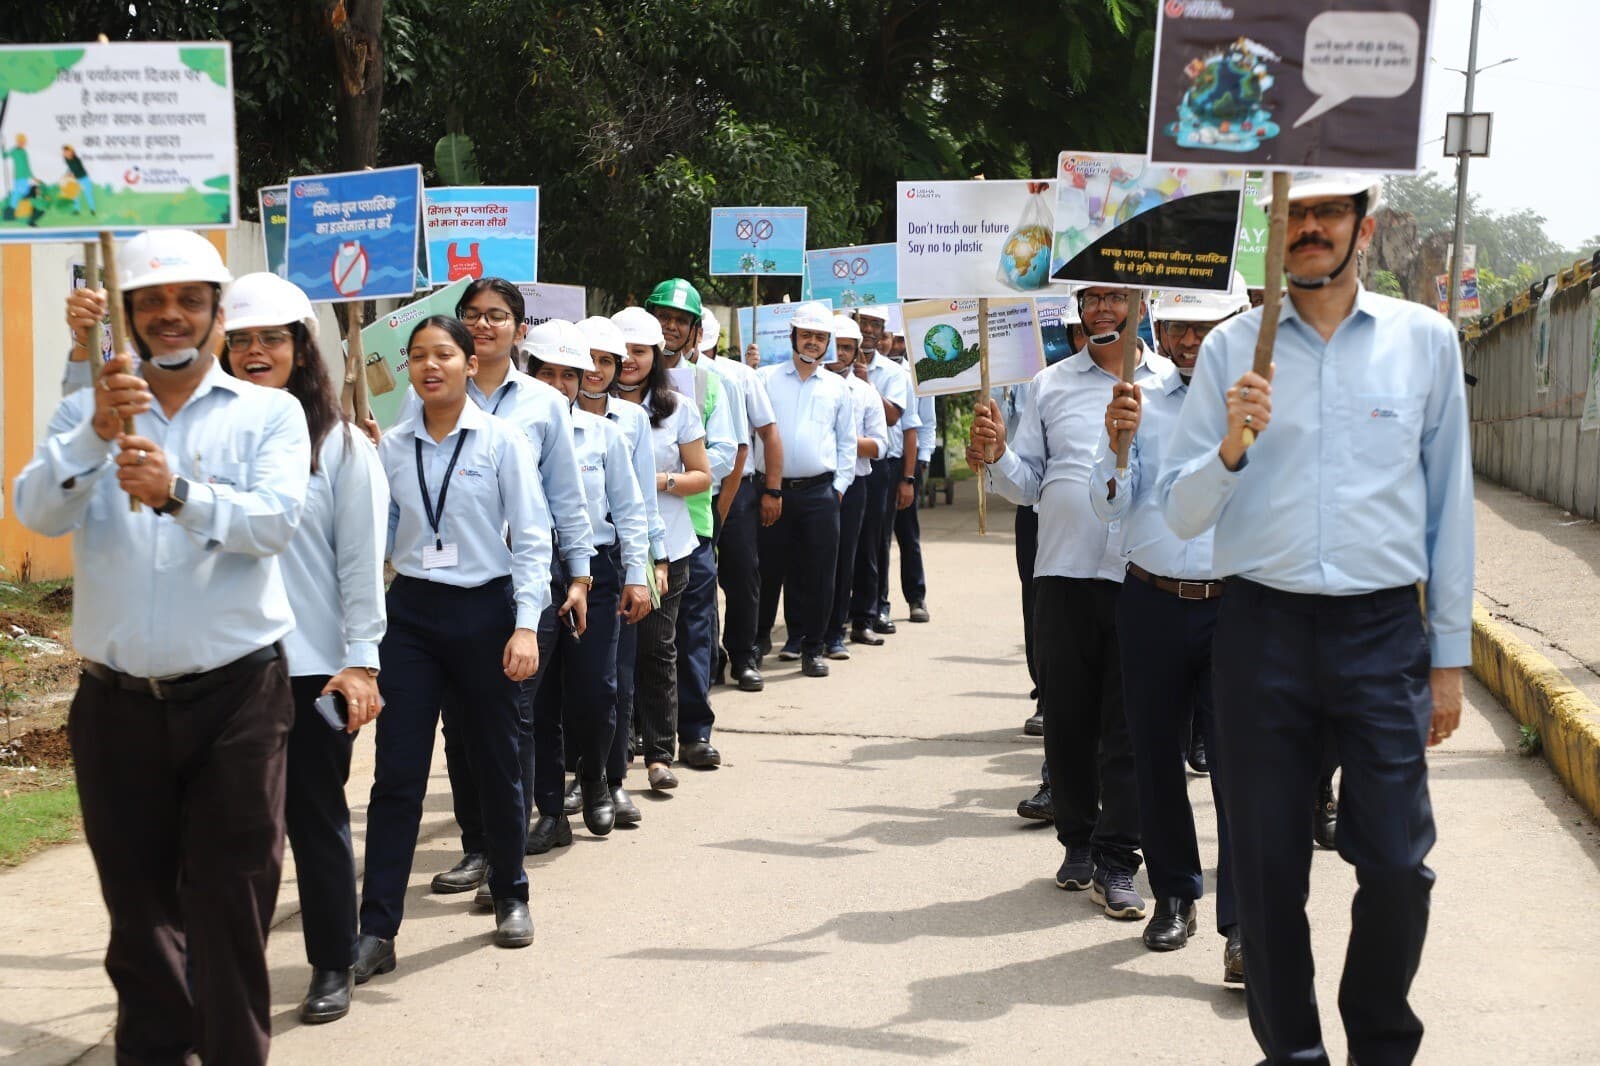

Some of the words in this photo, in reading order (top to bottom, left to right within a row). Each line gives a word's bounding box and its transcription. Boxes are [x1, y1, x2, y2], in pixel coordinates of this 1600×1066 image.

[471, 204, 509, 215] प्लास्टिक
[270, 214, 287, 225] Sin
[936, 221, 959, 235] trash
[962, 224, 978, 234] our
[981, 220, 1010, 234] future
[1239, 226, 1266, 243] AY
[908, 240, 925, 256] Say
[927, 243, 940, 253] no
[942, 242, 952, 252] to
[954, 240, 983, 255] plastic
[1237, 245, 1268, 253] PLAST
[524, 315, 552, 326] plast
